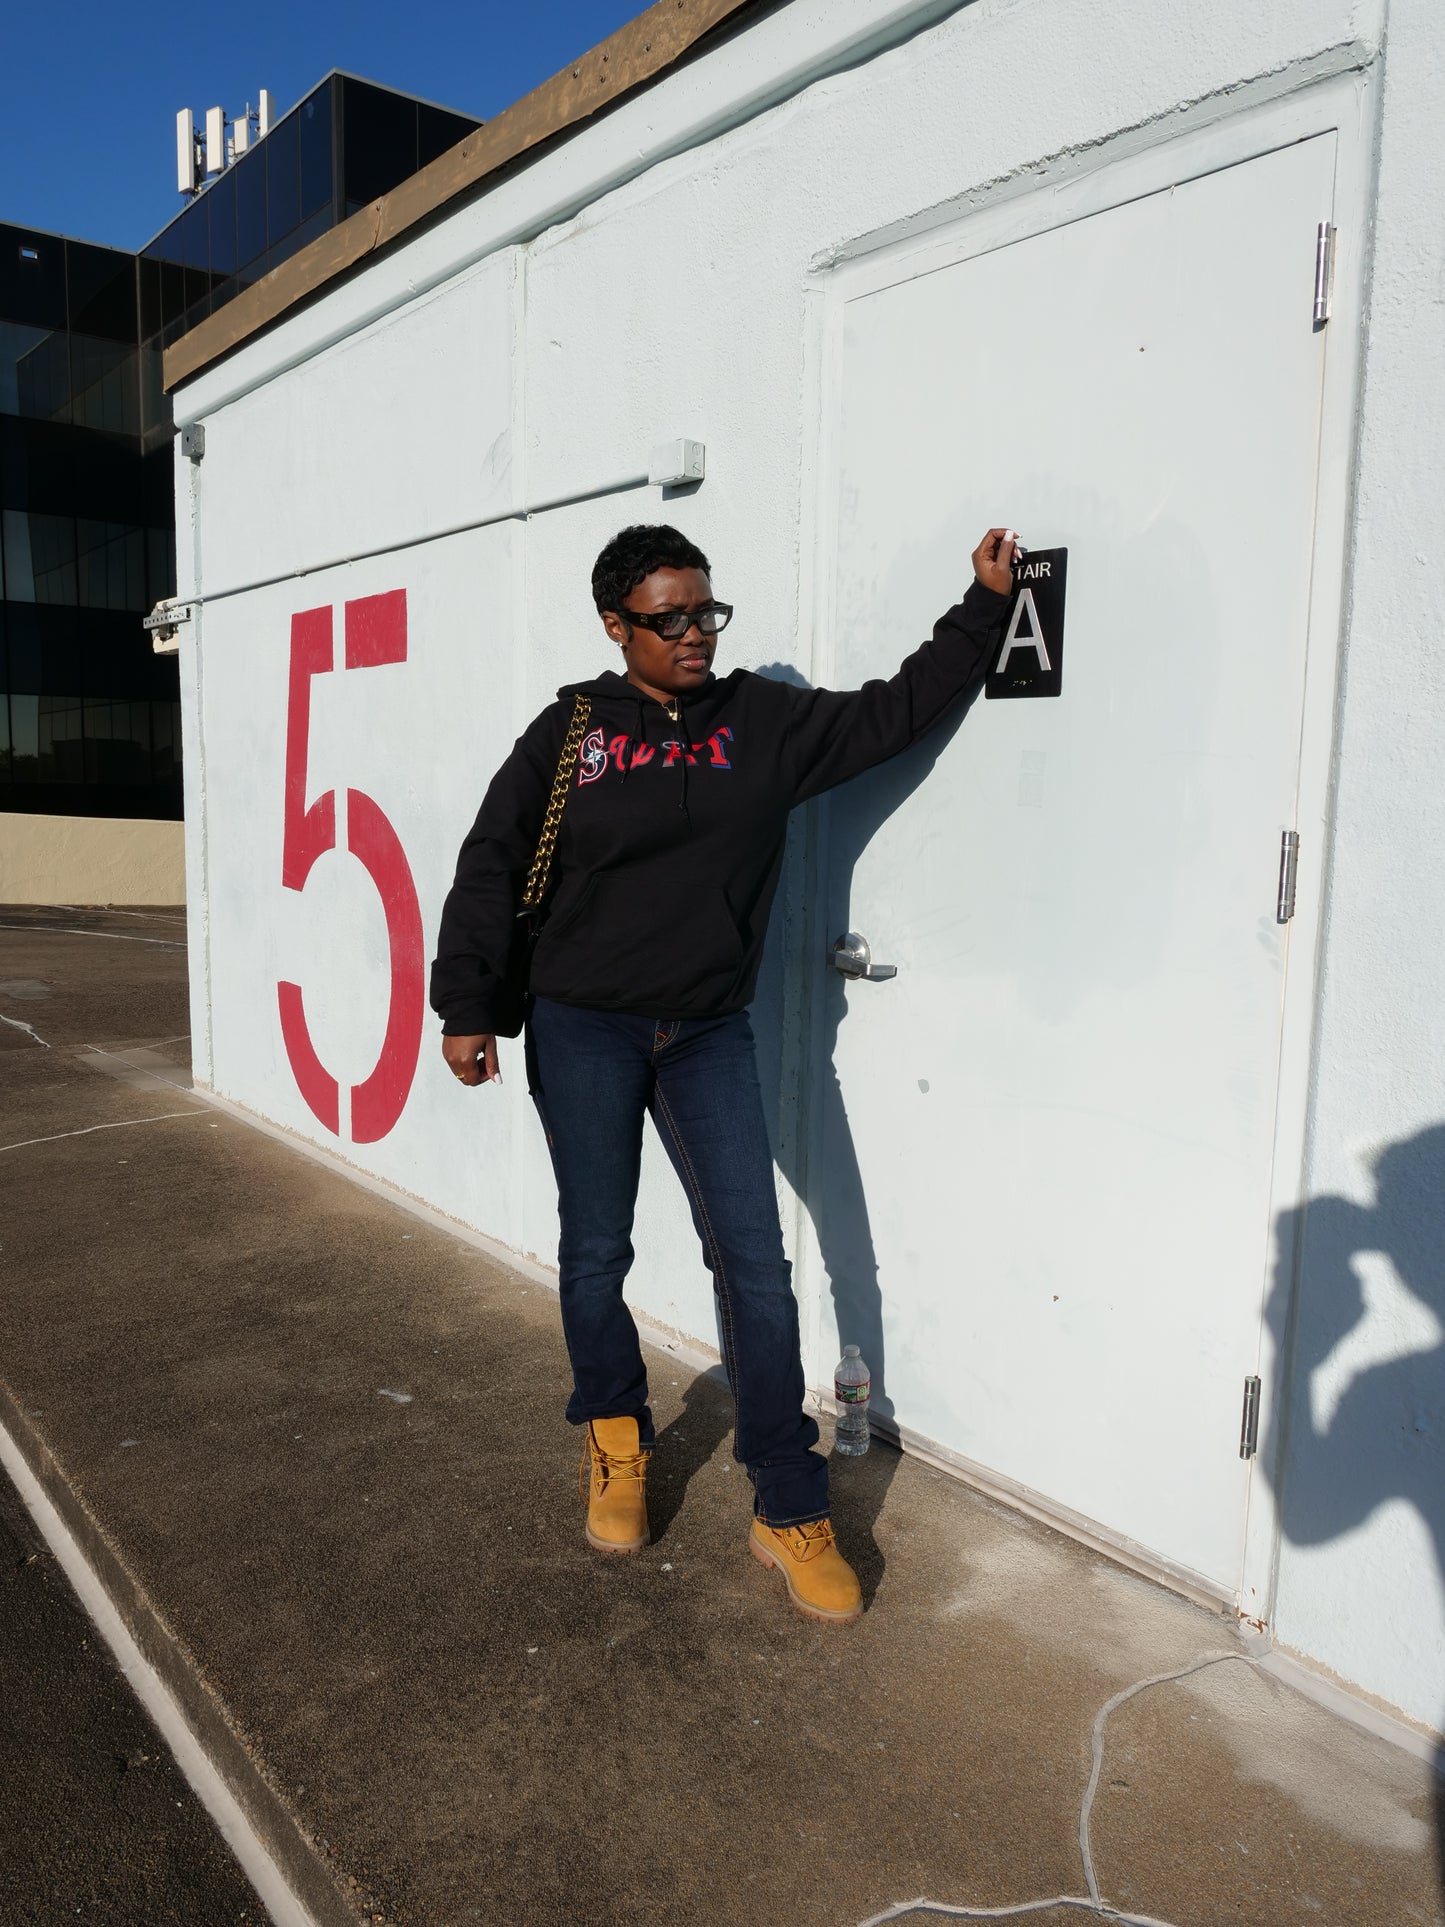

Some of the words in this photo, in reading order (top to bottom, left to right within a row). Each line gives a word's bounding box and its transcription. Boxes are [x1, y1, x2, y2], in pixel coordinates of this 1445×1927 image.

[1010, 561, 1051, 580] TAIR
[996, 588, 1051, 673] A
[277, 588, 425, 1144] 5
